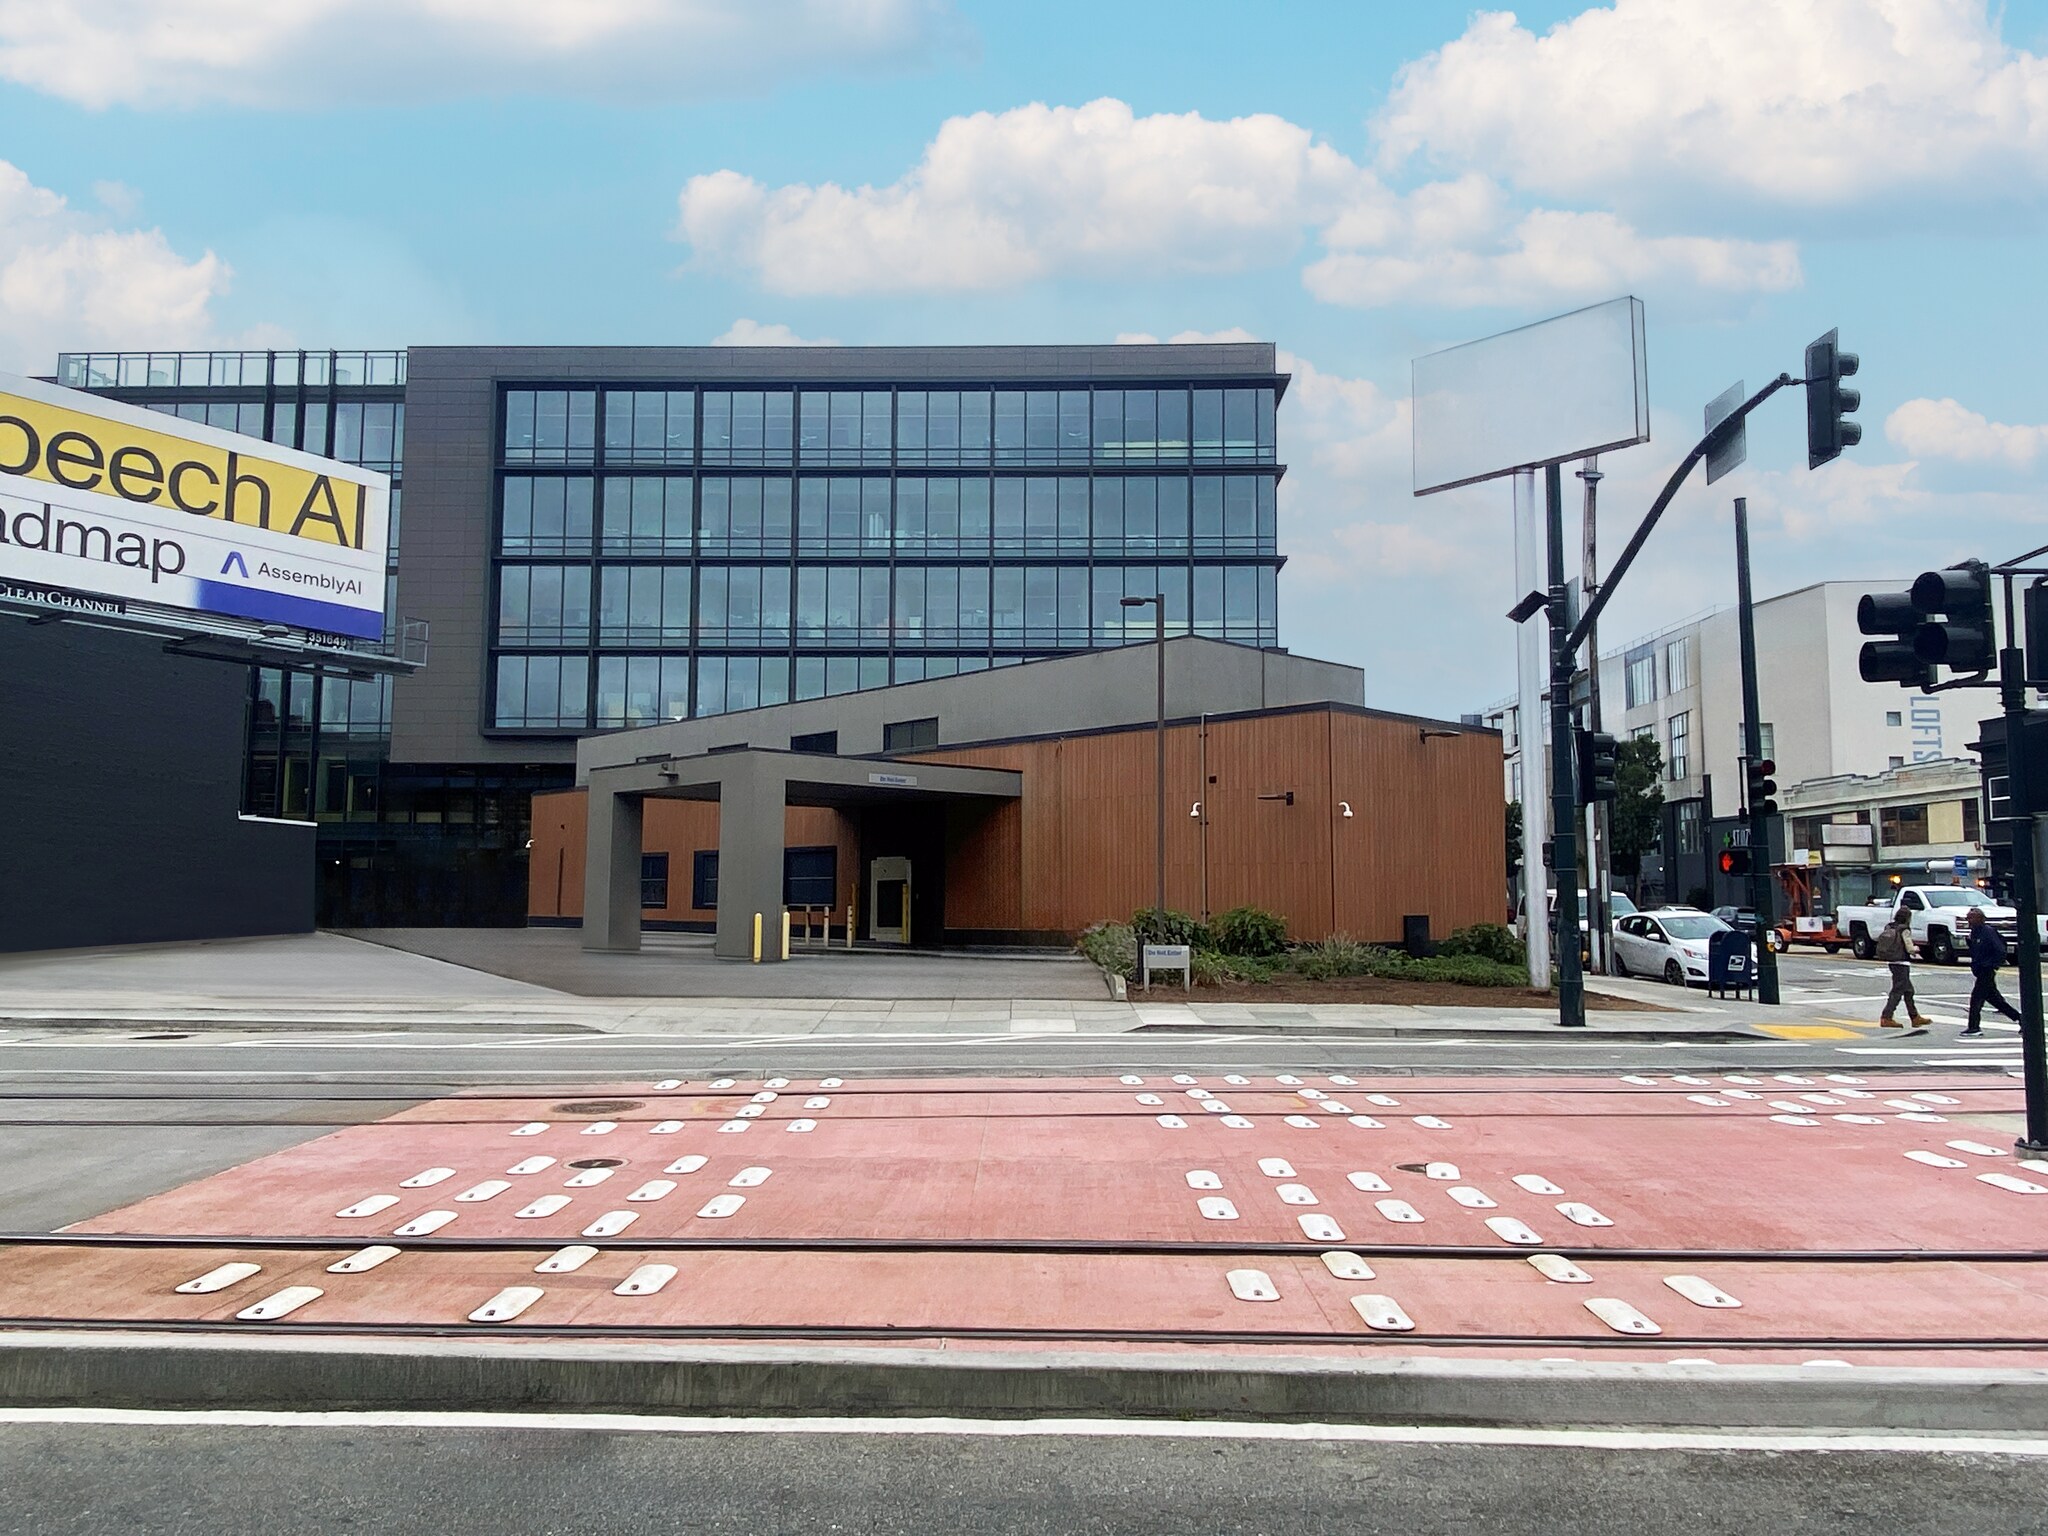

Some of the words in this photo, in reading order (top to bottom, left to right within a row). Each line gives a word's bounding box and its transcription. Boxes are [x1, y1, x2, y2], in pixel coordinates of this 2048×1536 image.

[0, 503, 185, 583] dmap
[289, 475, 366, 550] AI
[258, 562, 361, 594] AssemblyAI
[308, 631, 347, 646] 351649
[1910, 696, 1942, 761] LOFTS
